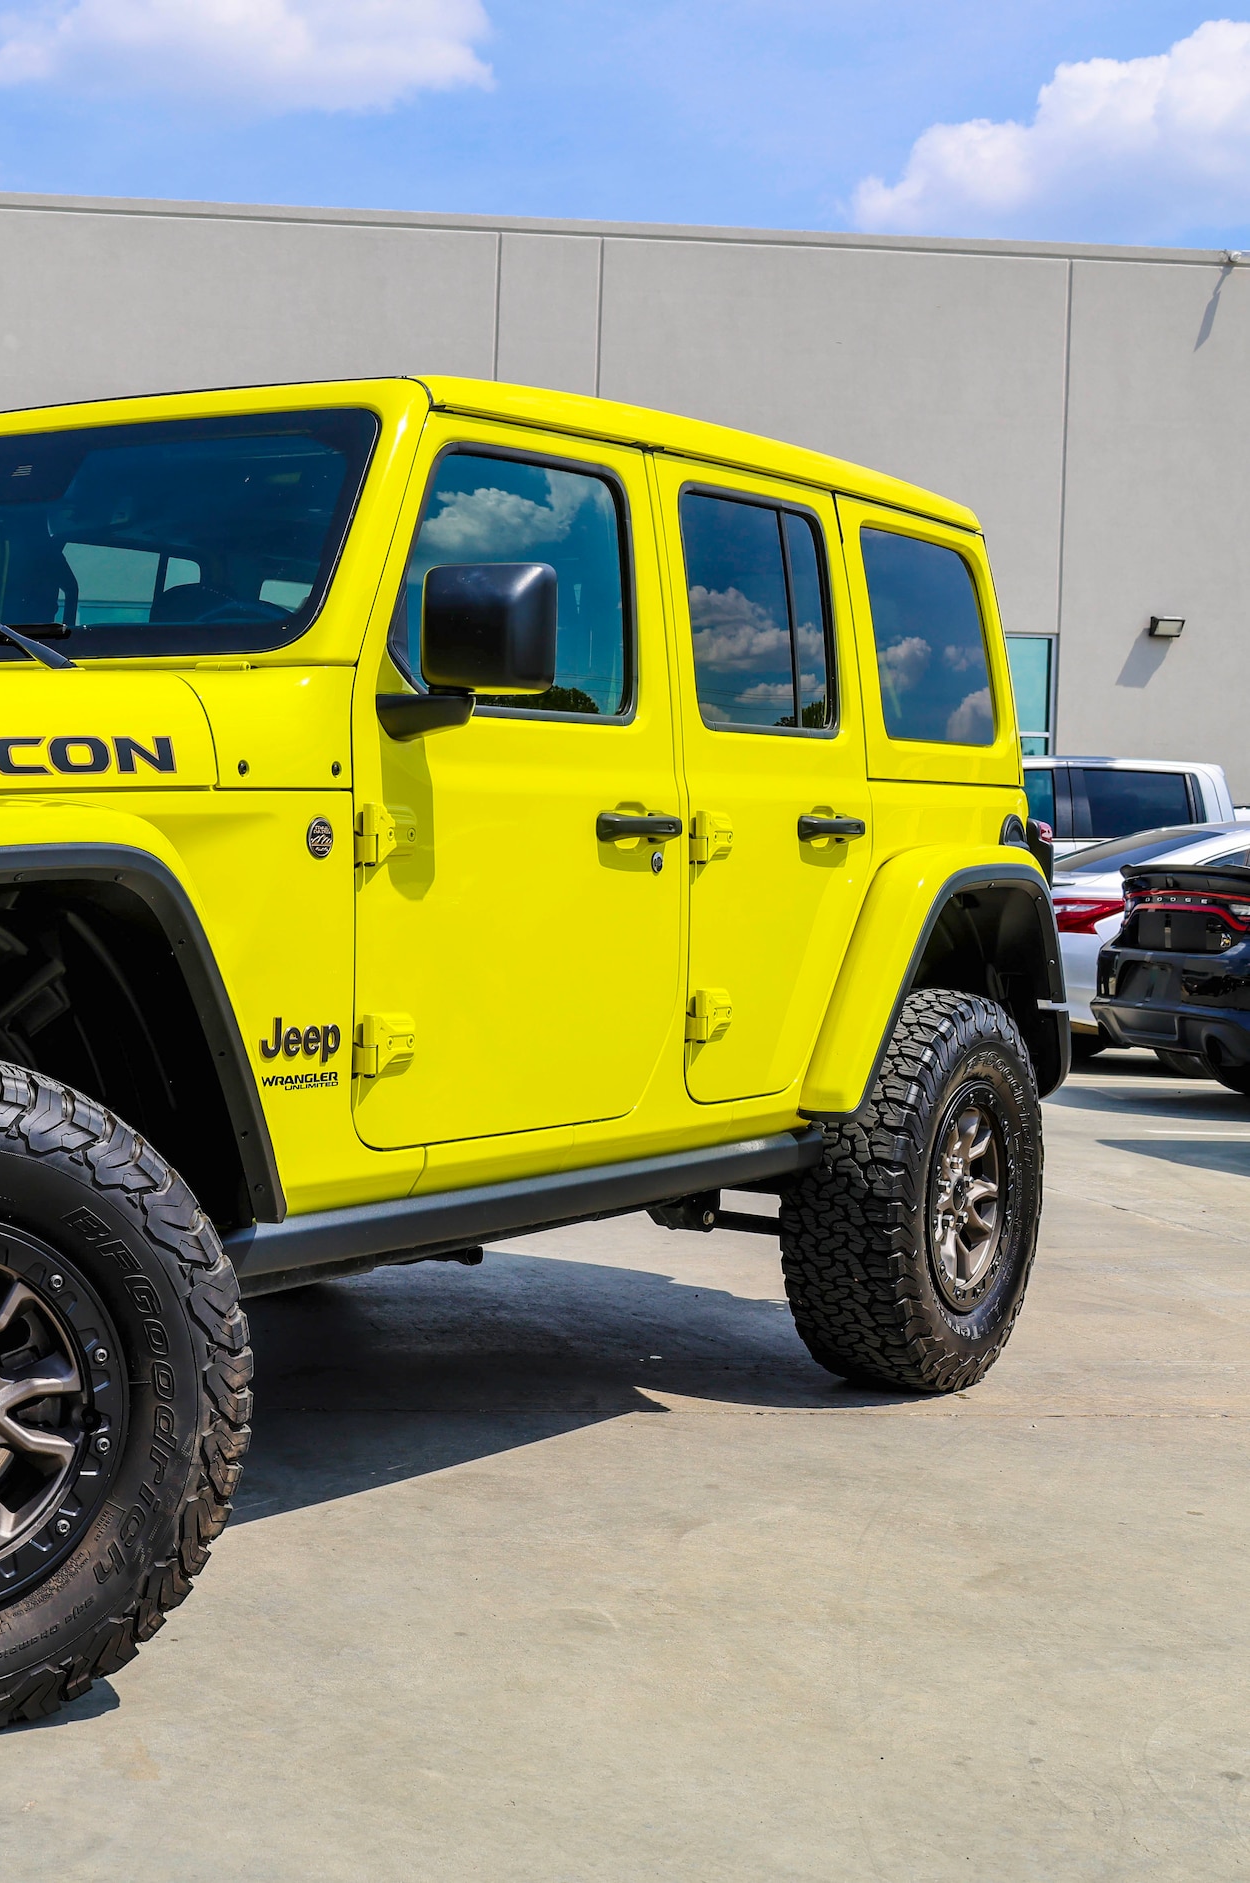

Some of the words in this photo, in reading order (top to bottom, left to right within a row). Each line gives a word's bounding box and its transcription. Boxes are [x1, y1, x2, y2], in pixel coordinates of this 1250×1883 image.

[1145, 896, 1208, 905] DODGE
[259, 1016, 341, 1064] Jeep
[261, 1071, 338, 1087] WRANGLER
[284, 1081, 339, 1091] UNLIMITED
[60, 1205, 179, 1586] BFGoodrich
